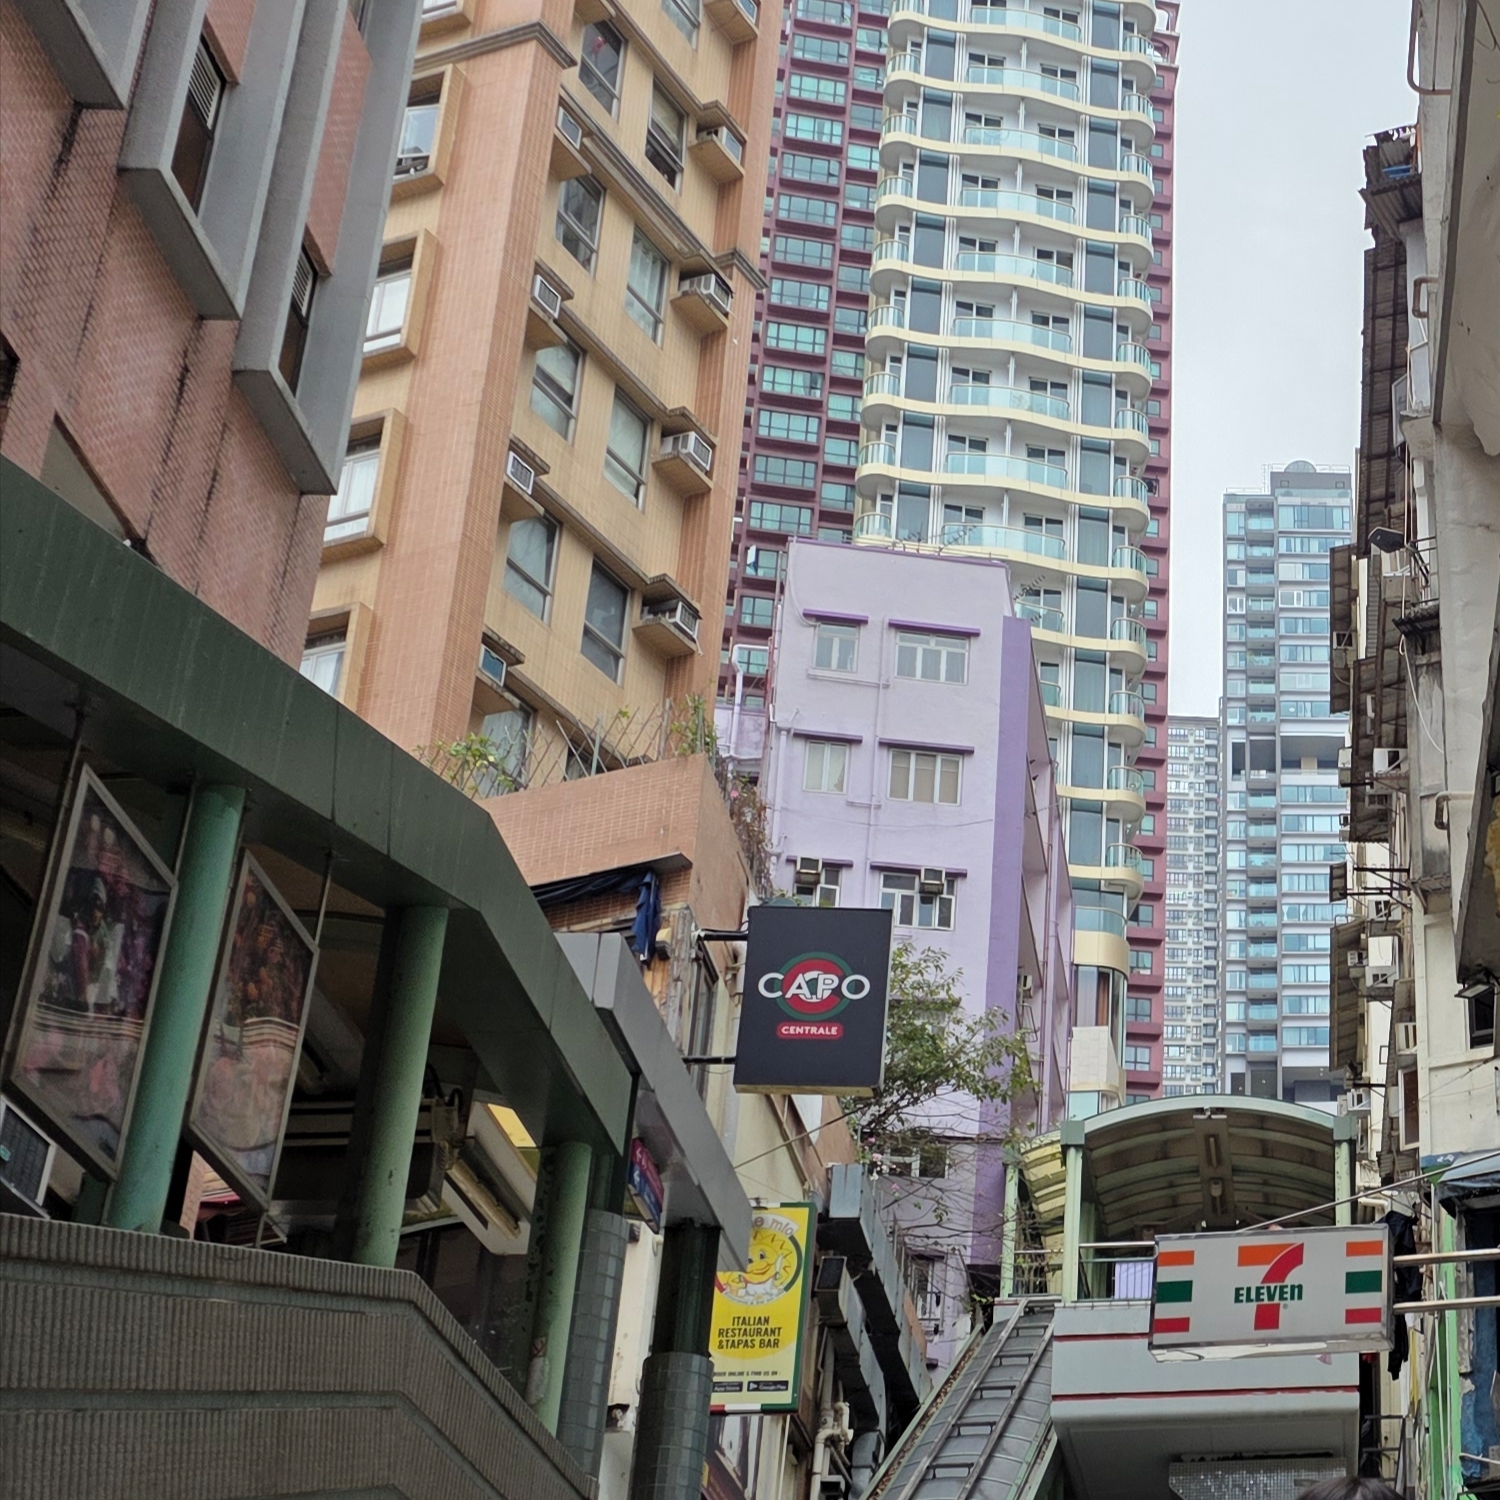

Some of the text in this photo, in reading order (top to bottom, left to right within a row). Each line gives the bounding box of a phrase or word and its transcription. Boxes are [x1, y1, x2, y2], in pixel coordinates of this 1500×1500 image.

[758, 971, 870, 1000] CAPO
[781, 1026, 838, 1036] CENTRALE
[1237, 1242, 1305, 1331] 7
[732, 1315, 770, 1327] ITALIAN
[717, 1327, 783, 1339] RESTAURANT
[717, 1337, 780, 1350] &TAPAS BAR
